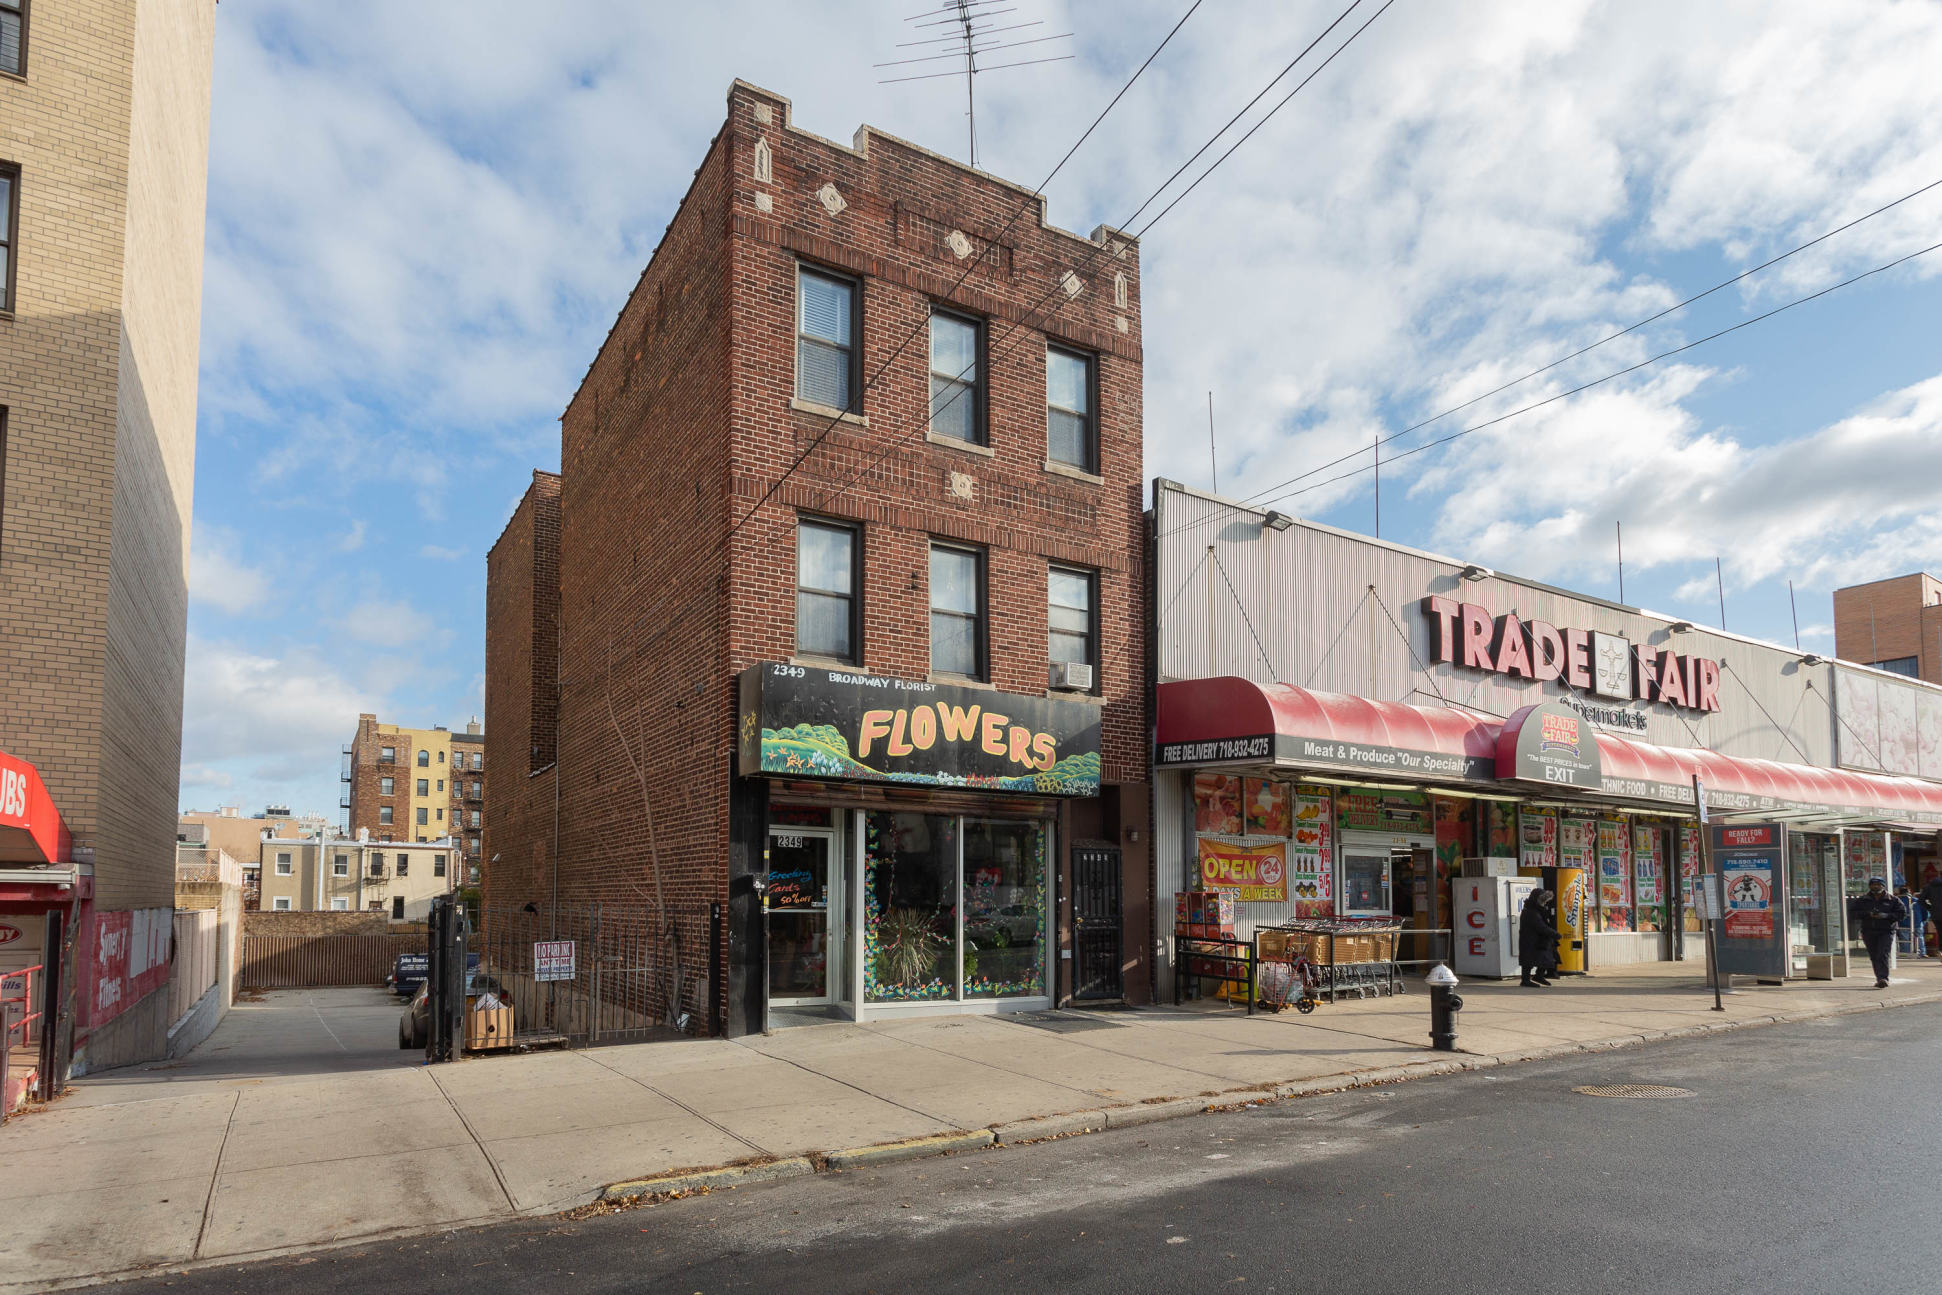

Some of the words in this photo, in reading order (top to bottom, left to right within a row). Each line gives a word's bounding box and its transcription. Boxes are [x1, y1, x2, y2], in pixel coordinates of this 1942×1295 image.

[1425, 595, 1591, 689] TRADE
[1630, 644, 1721, 713] FAIR
[773, 664, 806, 681] 2349
[829, 672, 890, 688] BROADWAY
[895, 681, 937, 692] FLORIST
[1543, 715, 1577, 732] TRADE
[858, 701, 1057, 771] FLOWERS
[1550, 729, 1571, 744] FAIR
[1163, 746, 1181, 762] FREE
[1182, 743, 1218, 760] DELIVERY
[1219, 738, 1269, 759] 718-932-4275
[1304, 741, 1333, 758] Meat
[1337, 747, 1346, 759] &
[1349, 747, 1396, 764] Produce
[1397, 751, 1421, 767] "Our
[1423, 755, 1475, 775] Specialty"
[1540, 756, 1553, 764] BEST
[1554, 758, 1572, 767] PRICES
[1545, 765, 1575, 784] EXIT
[1626, 781, 1647, 796] FOOD
[1659, 784, 1677, 799] FREE
[1348, 794, 1378, 813] FREE
[779, 836, 802, 847] 2349
[1728, 830, 1748, 838] READY
[1750, 829, 1763, 837] FOR
[1736, 836, 1755, 844] FALL?
[1204, 857, 1257, 881] OPEN
[1263, 860, 1280, 876] 24
[1243, 888, 1251, 899] A
[1254, 888, 1283, 900] WEEK
[1566, 873, 1582, 928] Snapple
[1467, 886, 1486, 956] ICE
